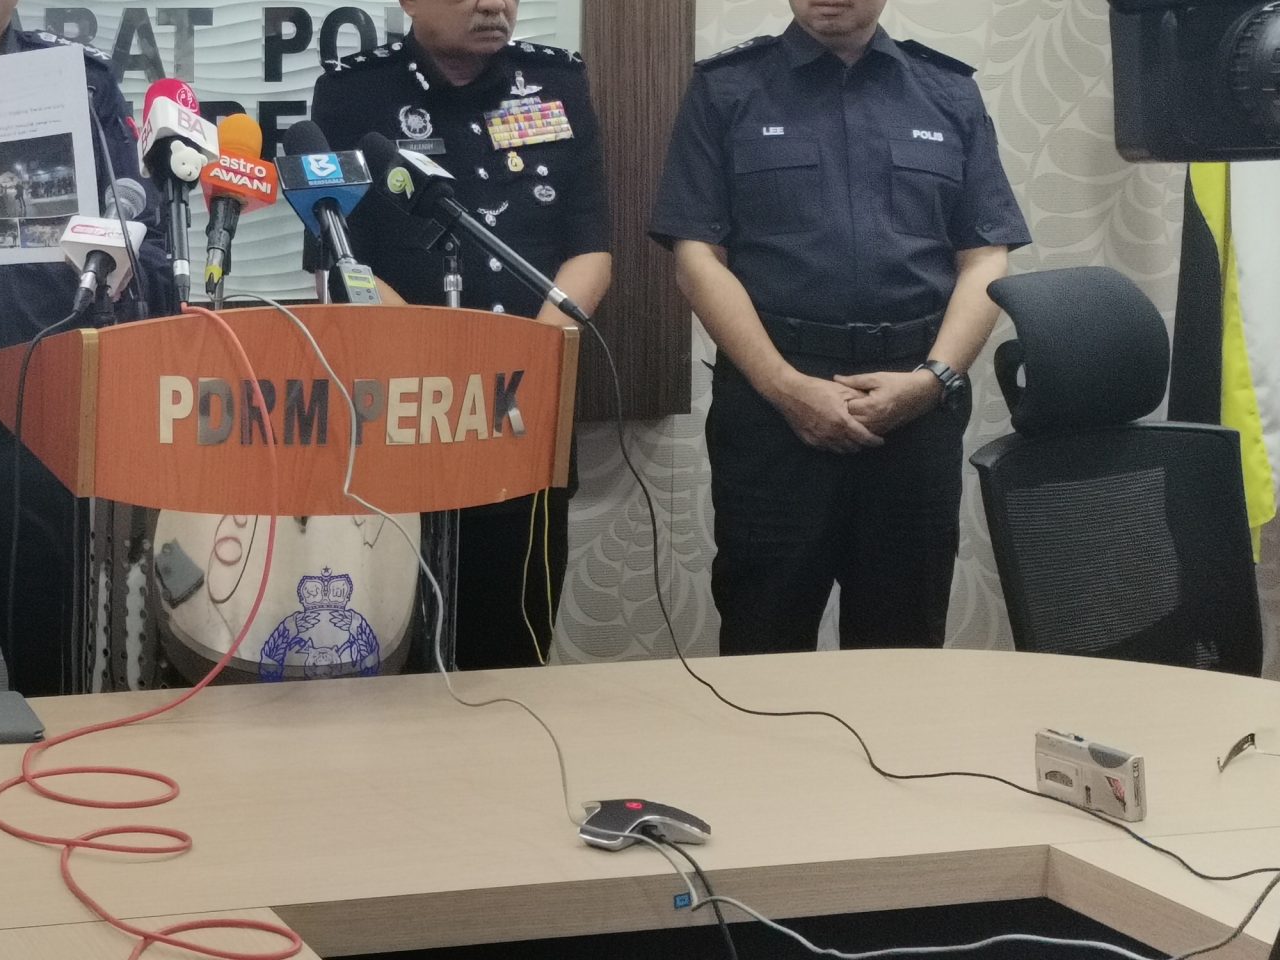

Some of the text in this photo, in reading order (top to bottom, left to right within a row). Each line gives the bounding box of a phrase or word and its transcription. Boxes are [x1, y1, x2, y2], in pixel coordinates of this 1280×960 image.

[763, 126, 785, 136] LEE
[912, 129, 944, 142] POLIS
[219, 155, 267, 178] astro
[209, 167, 272, 195] AWANI
[159, 370, 526, 446] PDRM PERAK
